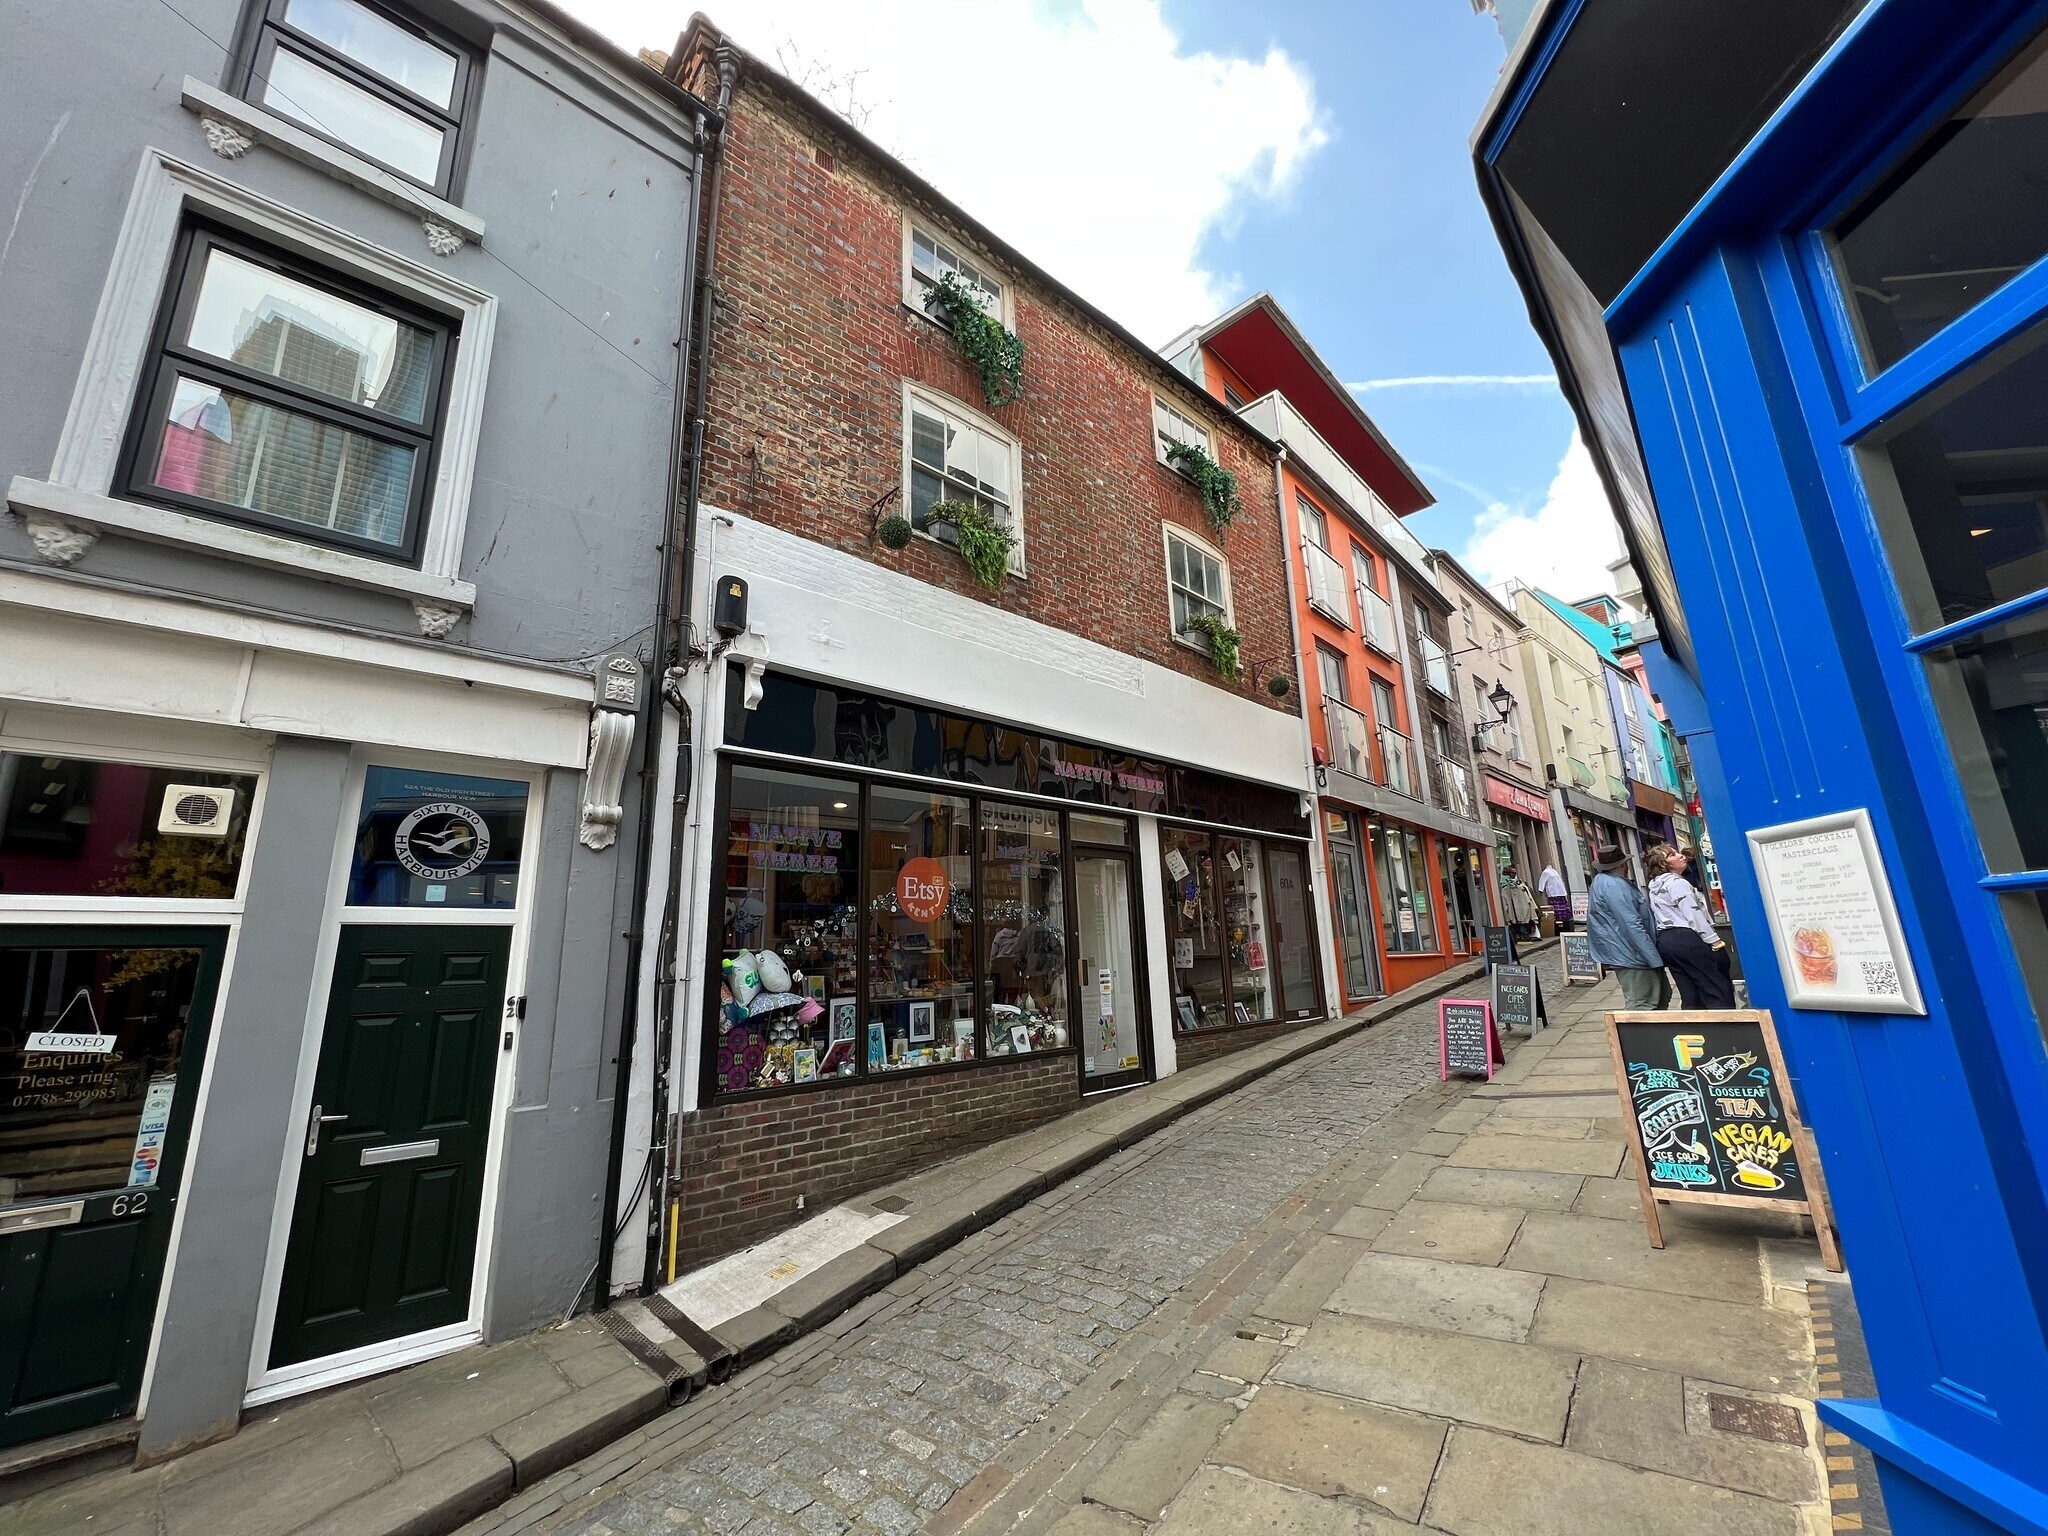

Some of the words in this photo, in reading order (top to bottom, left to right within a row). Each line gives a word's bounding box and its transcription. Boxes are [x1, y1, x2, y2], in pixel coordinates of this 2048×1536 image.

[1054, 760, 1112, 785] NATIVE
[1118, 773, 1164, 794] THREE
[413, 804, 451, 820] SIXTY
[455, 806, 480, 825] TWO
[750, 822, 842, 848] NATIVE
[1765, 839, 1804, 851] FOLKLORE
[1808, 831, 1853, 844] COCKTAIL
[396, 835, 458, 879] HARBOUR
[462, 837, 489, 870] VIEW
[752, 851, 838, 874] THREE
[1782, 845, 1838, 860] MASTERCLASS
[903, 876, 945, 907] Etsy
[1280, 878, 1294, 890] 60A
[908, 902, 935, 918] KENT
[1500, 985, 1513, 993] NICE
[1514, 986, 1528, 994] CARDS
[38, 1036, 105, 1047] CLOSED
[23, 1051, 124, 1070] Enquiries
[1673, 1034, 1705, 1070] F
[18, 1074, 74, 1089] Please
[1644, 1070, 1673, 1078] TAKE
[12, 1088, 117, 1107] 07788-299985
[1708, 1086, 1743, 1097] LOOSE
[1743, 1088, 1766, 1098] LEAF
[1715, 1098, 1766, 1118] TEA
[145, 1122, 164, 1130] VISA
[1644, 1100, 1699, 1138] COFFEE
[1712, 1123, 1793, 1153] VEGAN
[1656, 1151, 1674, 1160] ICE
[1677, 1152, 1699, 1161] COLD
[1726, 1143, 1779, 1169] CAKES
[1652, 1161, 1712, 1182] DRINKS
[112, 1193, 148, 1216] 62
